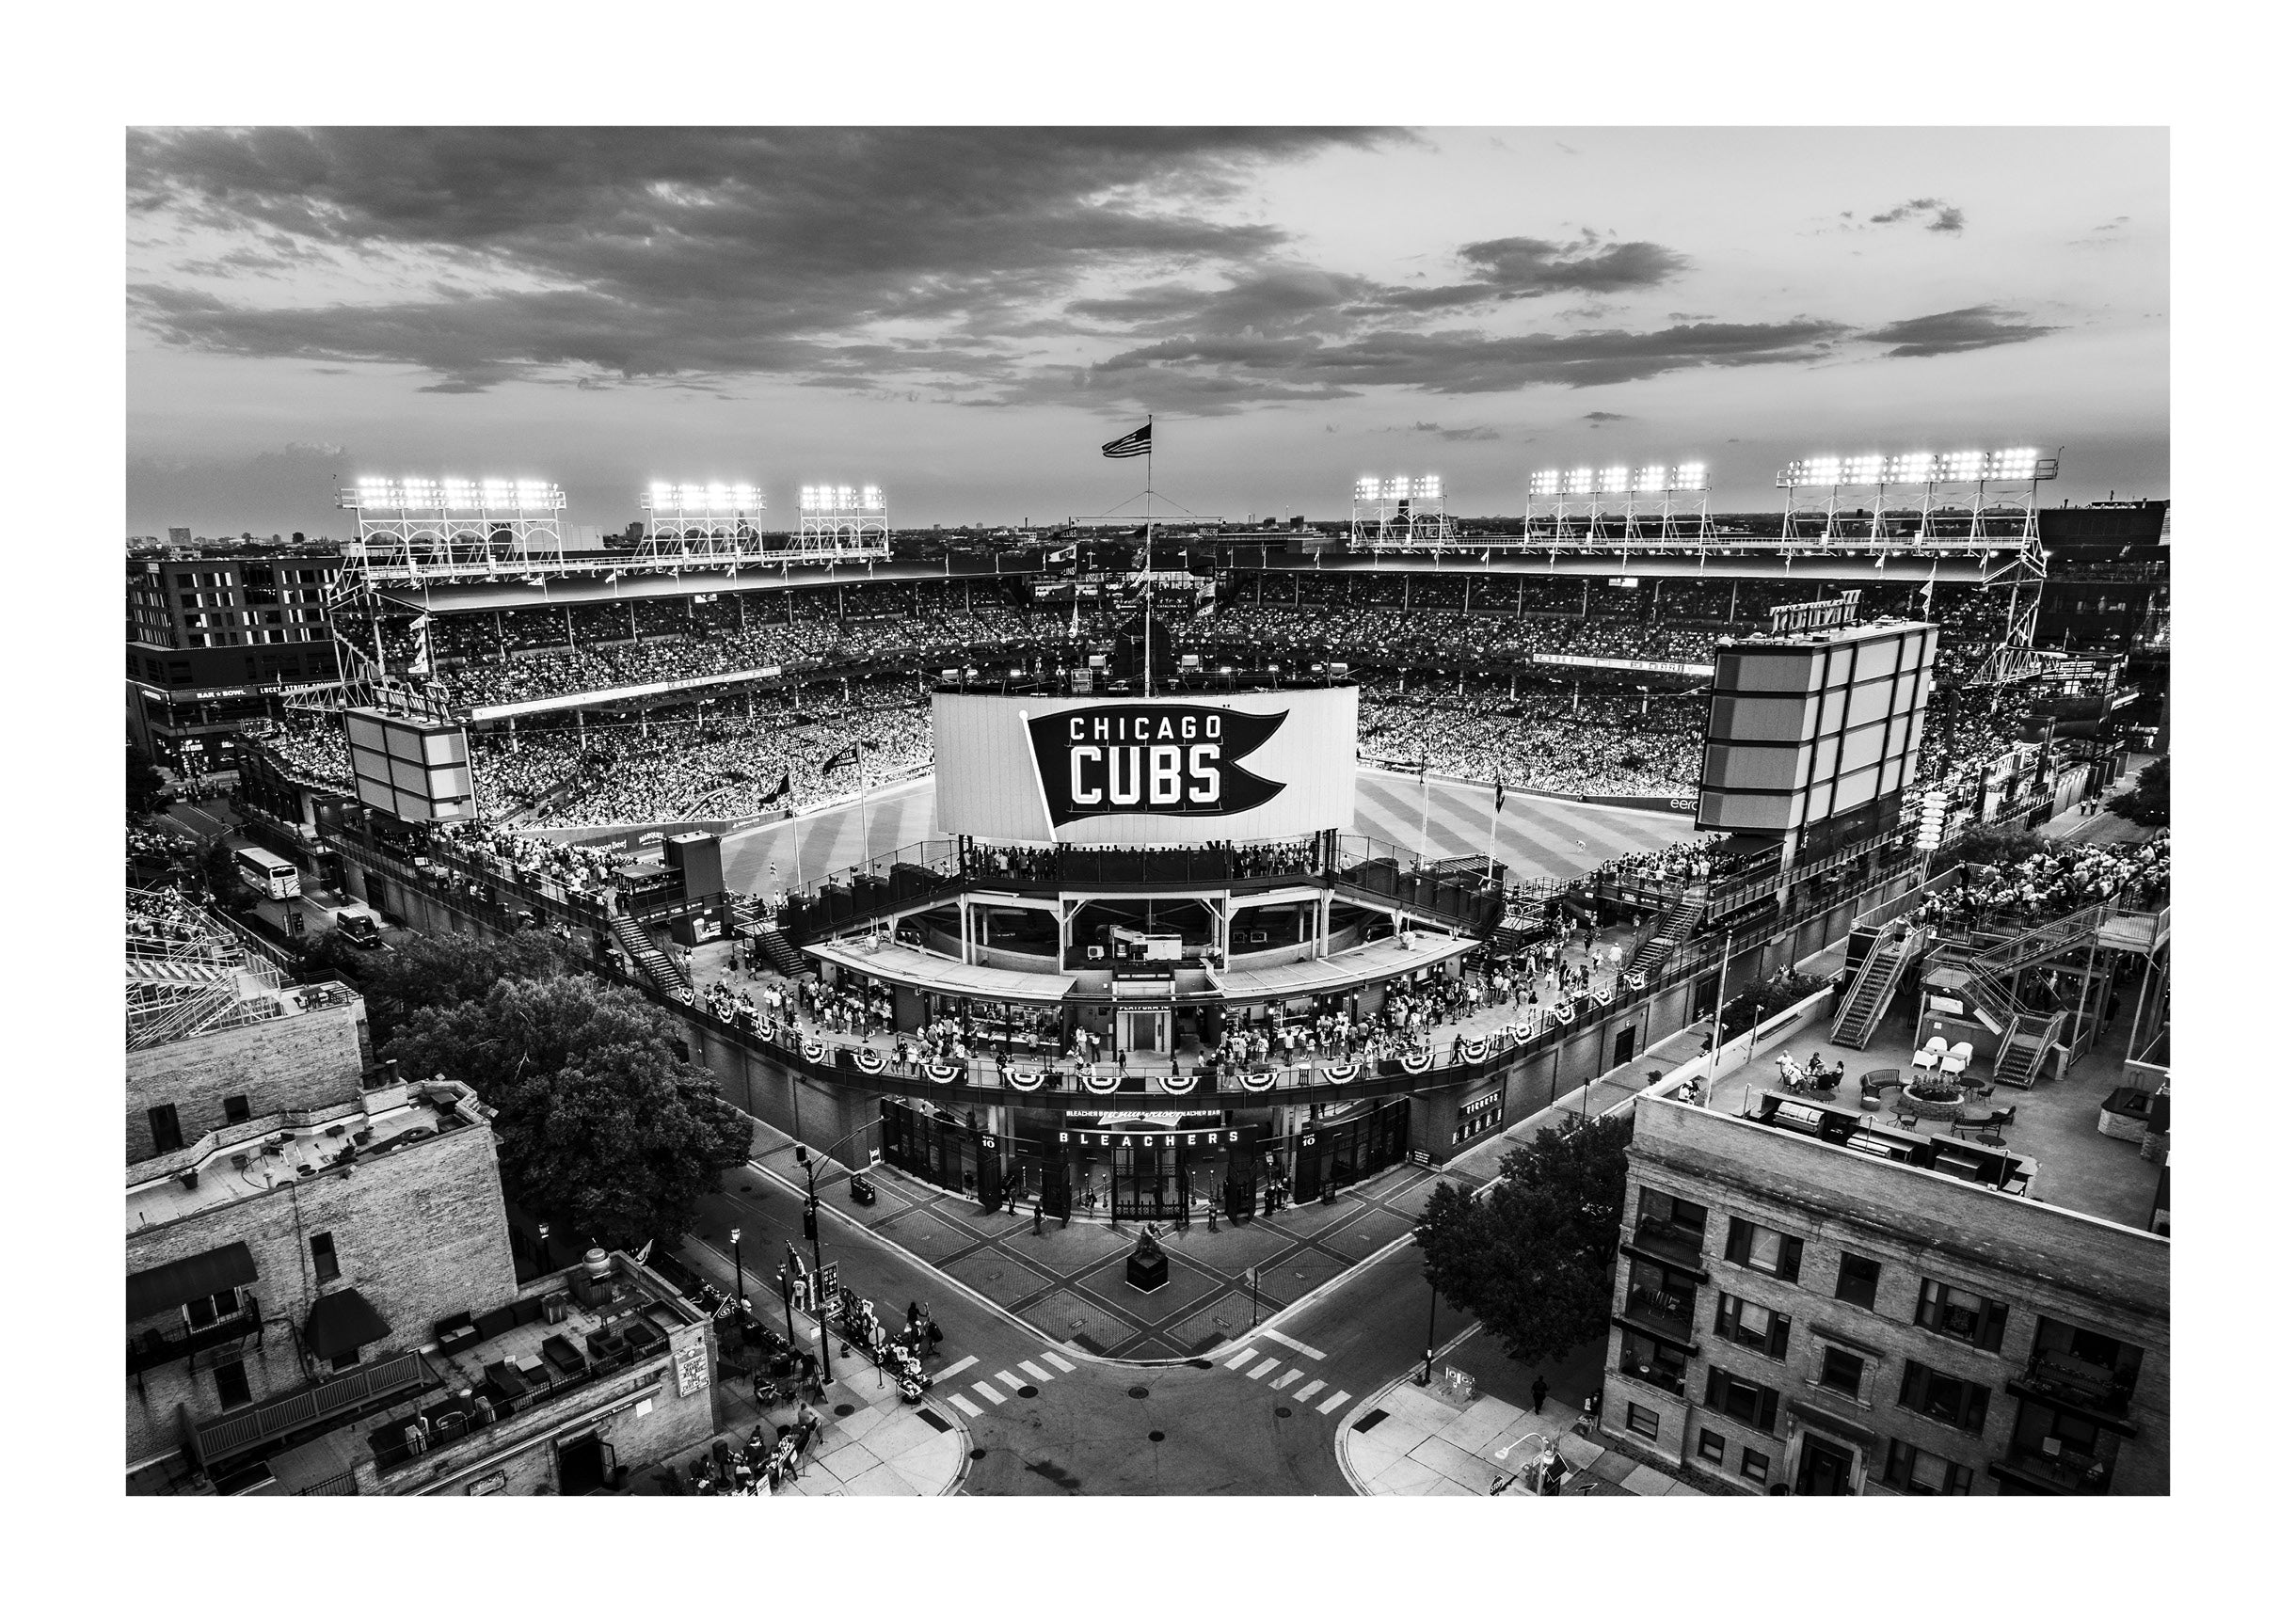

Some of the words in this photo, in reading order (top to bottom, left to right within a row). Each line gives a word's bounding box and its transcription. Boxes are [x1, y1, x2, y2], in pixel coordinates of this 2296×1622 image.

[222, 689, 247, 698] BOWL
[260, 686, 281, 694] LUCKY
[1070, 715, 1221, 740] CHICAGO
[1070, 744, 1220, 805] CUBS
[639, 832, 665, 844] MARQUEE
[1466, 1093, 1498, 1115] TICKETS
[981, 1139, 996, 1149] 10
[1059, 1131, 1238, 1148] BLEACHERS
[1302, 1137, 1315, 1147] 10
[1491, 1479, 1503, 1493] STOP
